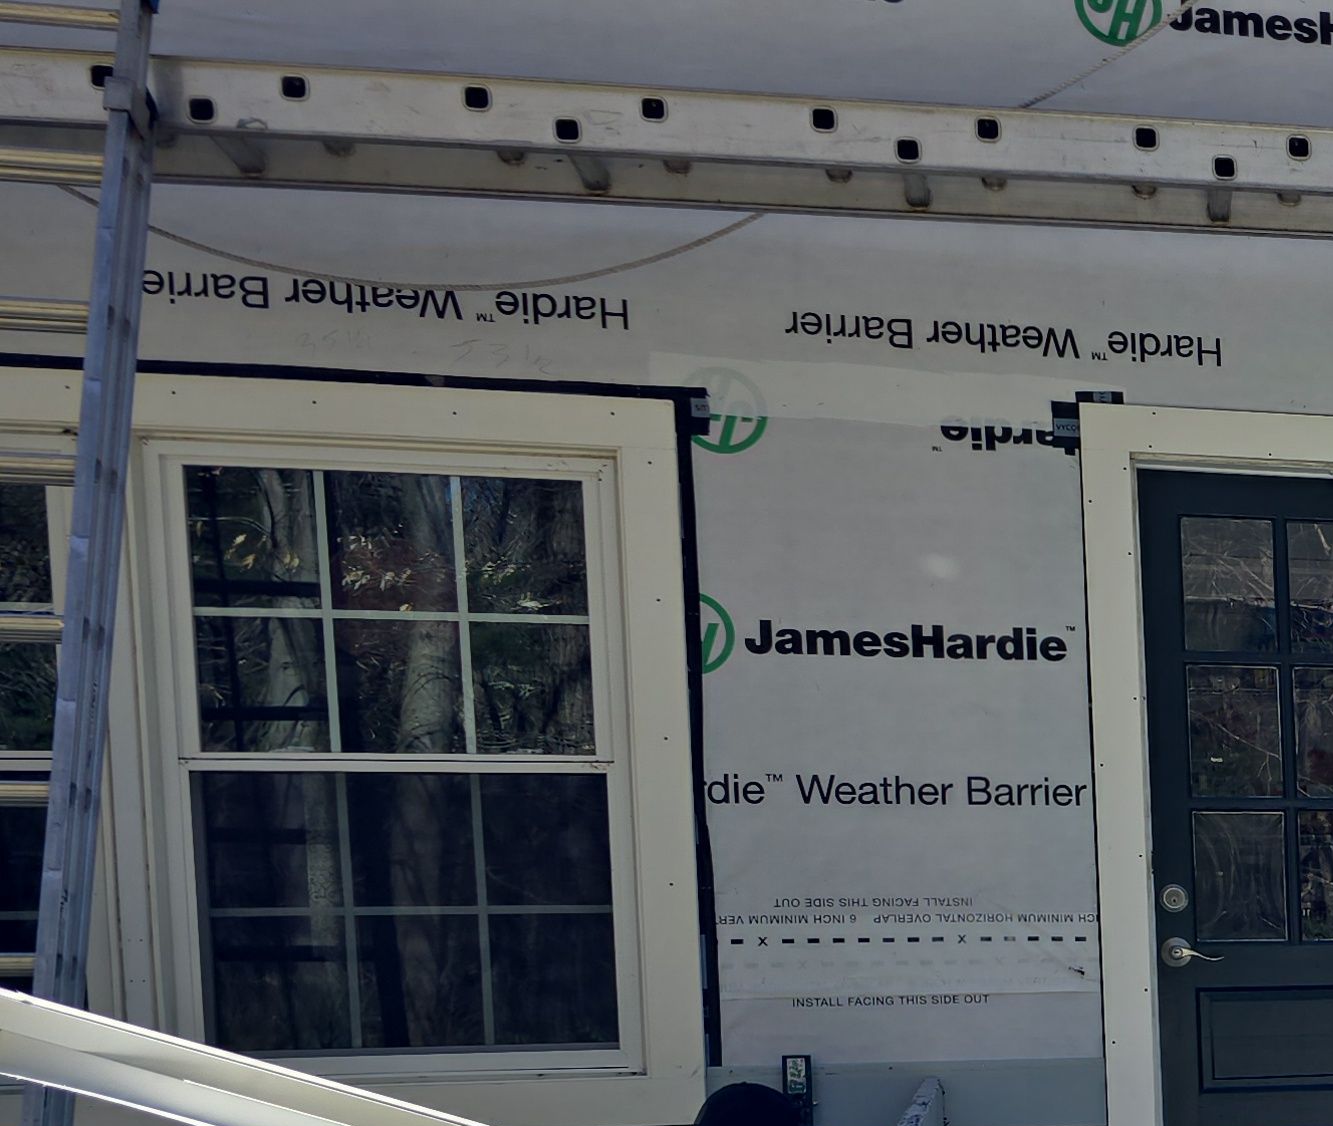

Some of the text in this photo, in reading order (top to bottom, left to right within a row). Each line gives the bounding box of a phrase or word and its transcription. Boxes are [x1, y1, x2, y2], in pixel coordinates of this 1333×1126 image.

[287, 278, 463, 321] Weather
[784, 311, 913, 350] Barrier
[926, 320, 1080, 359] Weather
[795, 774, 954, 806] Weather
[967, 776, 1088, 807] Barrier
[773, 896, 973, 909] INSTALL FACING THIS SIDE OUT
[754, 914, 814, 925] MINIMUM
[817, 914, 846, 925] INCH
[873, 913, 932, 925] OVERLAP
[934, 913, 1013, 924] HORIZONTAL
[1016, 913, 1074, 924] MINIMUM
[791, 991, 991, 1009] INSTALL FACING THIS SIDE OUT
